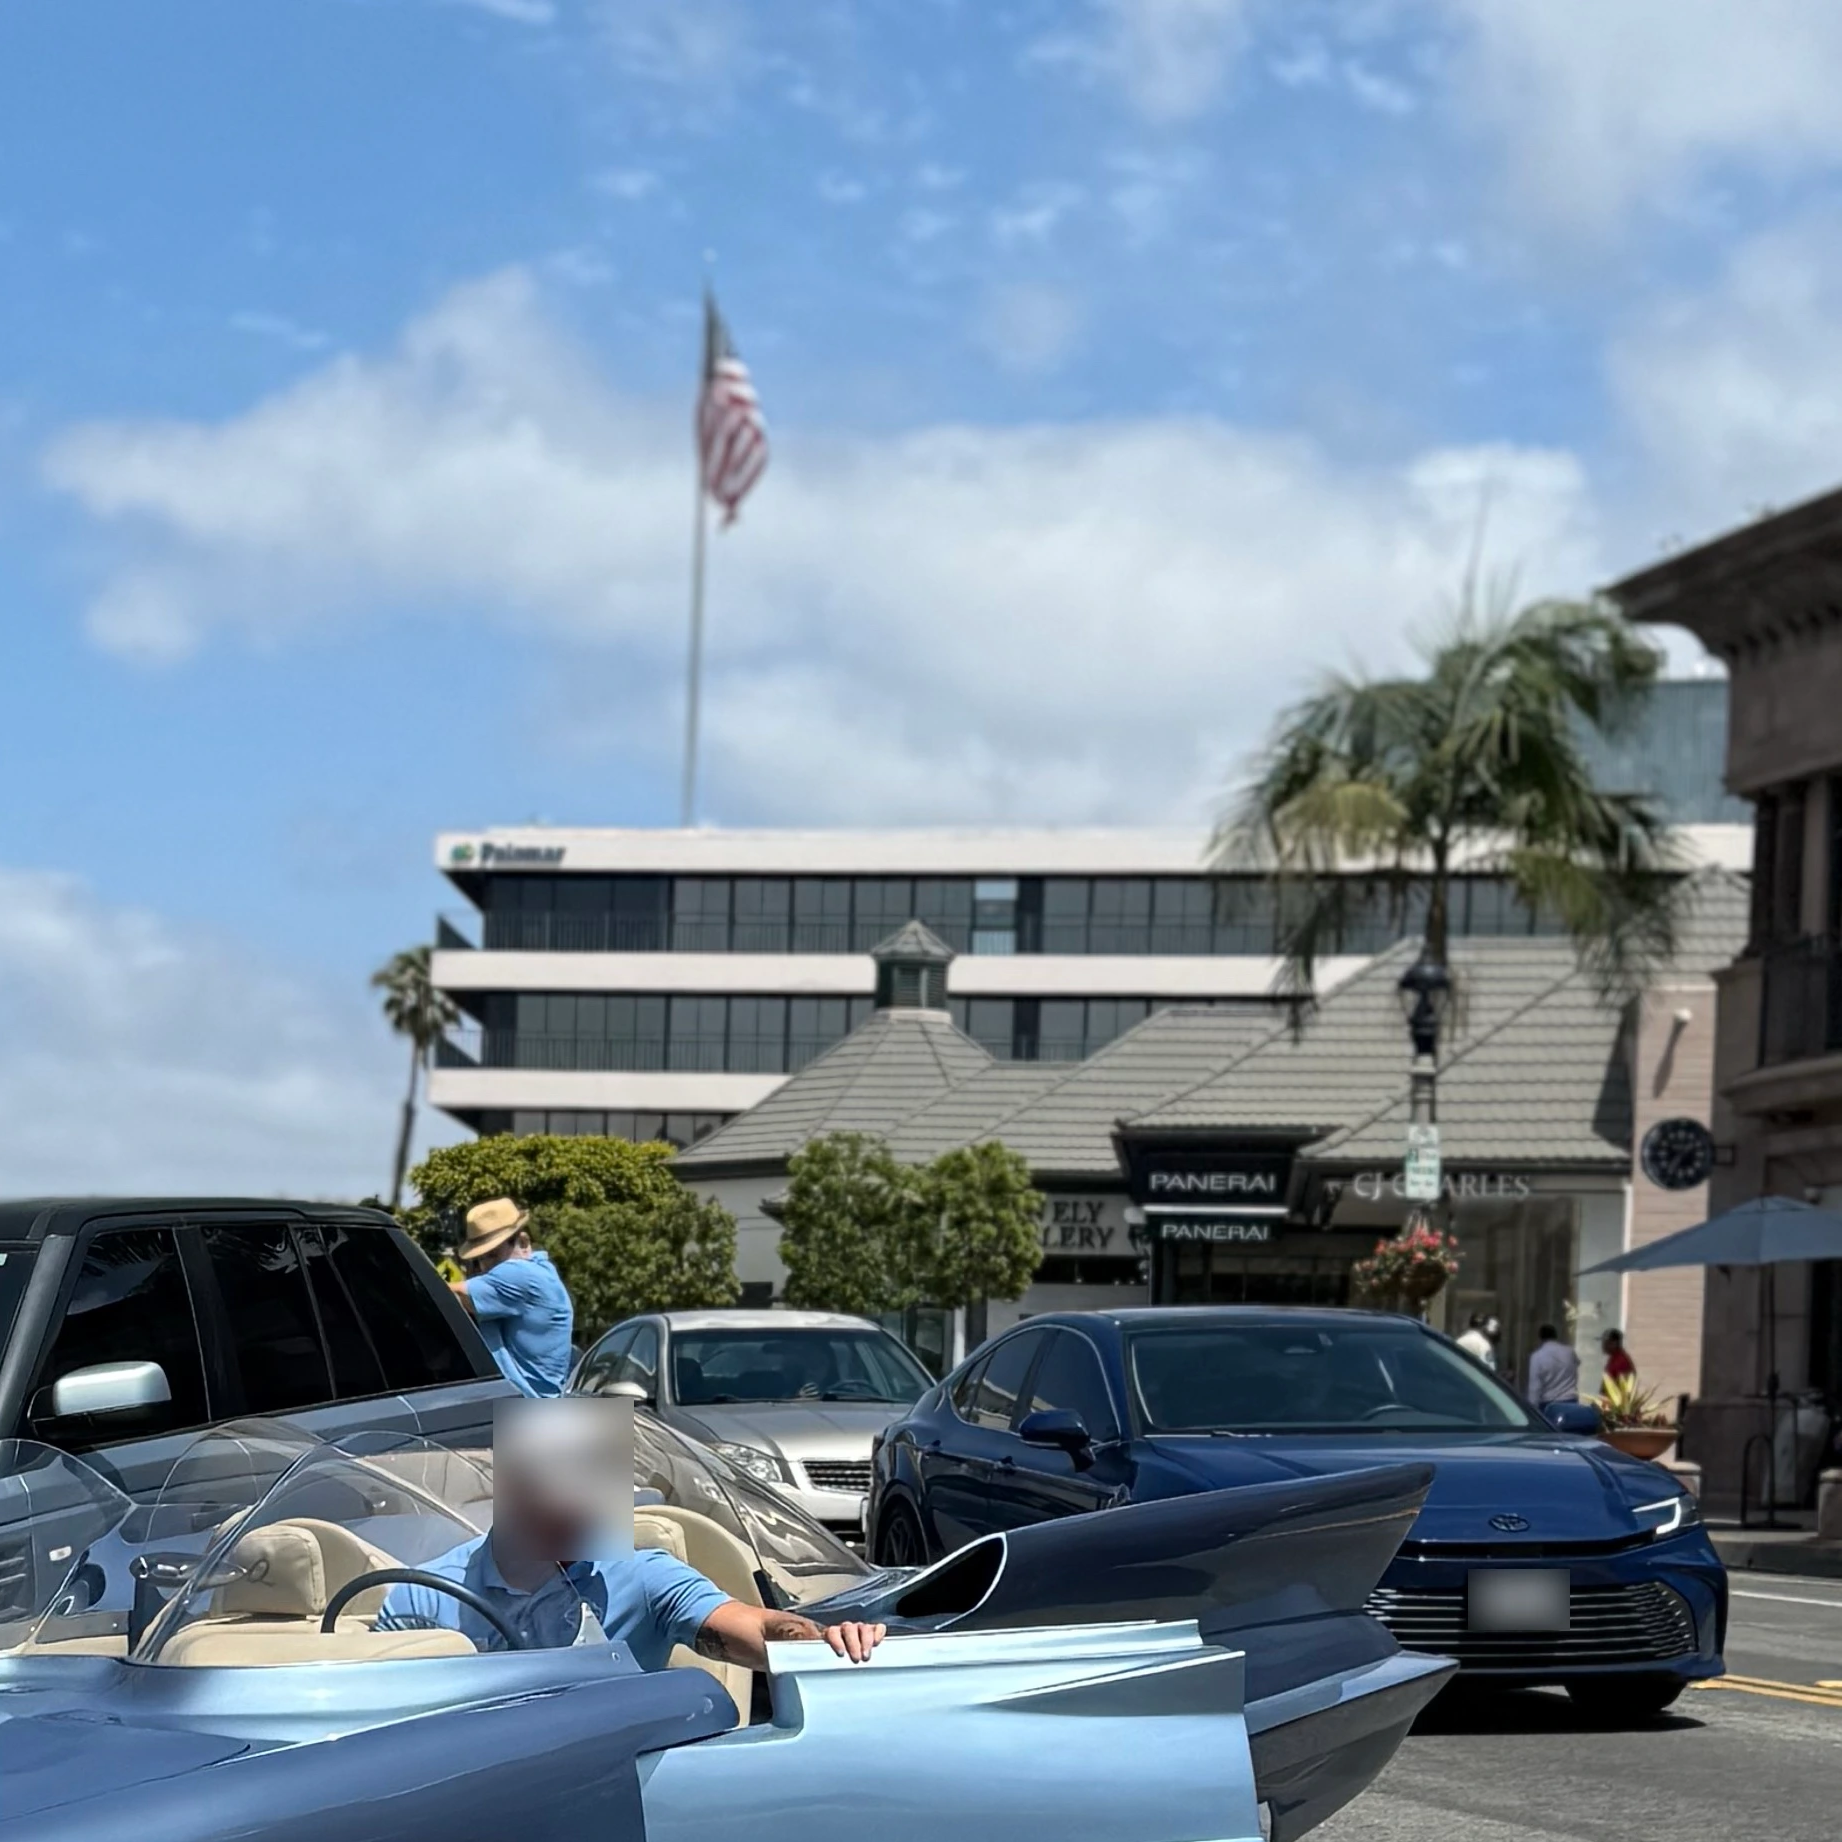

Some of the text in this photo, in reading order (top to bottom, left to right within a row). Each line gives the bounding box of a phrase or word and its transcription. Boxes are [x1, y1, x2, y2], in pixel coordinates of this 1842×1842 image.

[1150, 1173, 1275, 1192] PANERAI
[1392, 1173, 1530, 1198] CARLES
[1161, 1223, 1268, 1241] PANERAI
